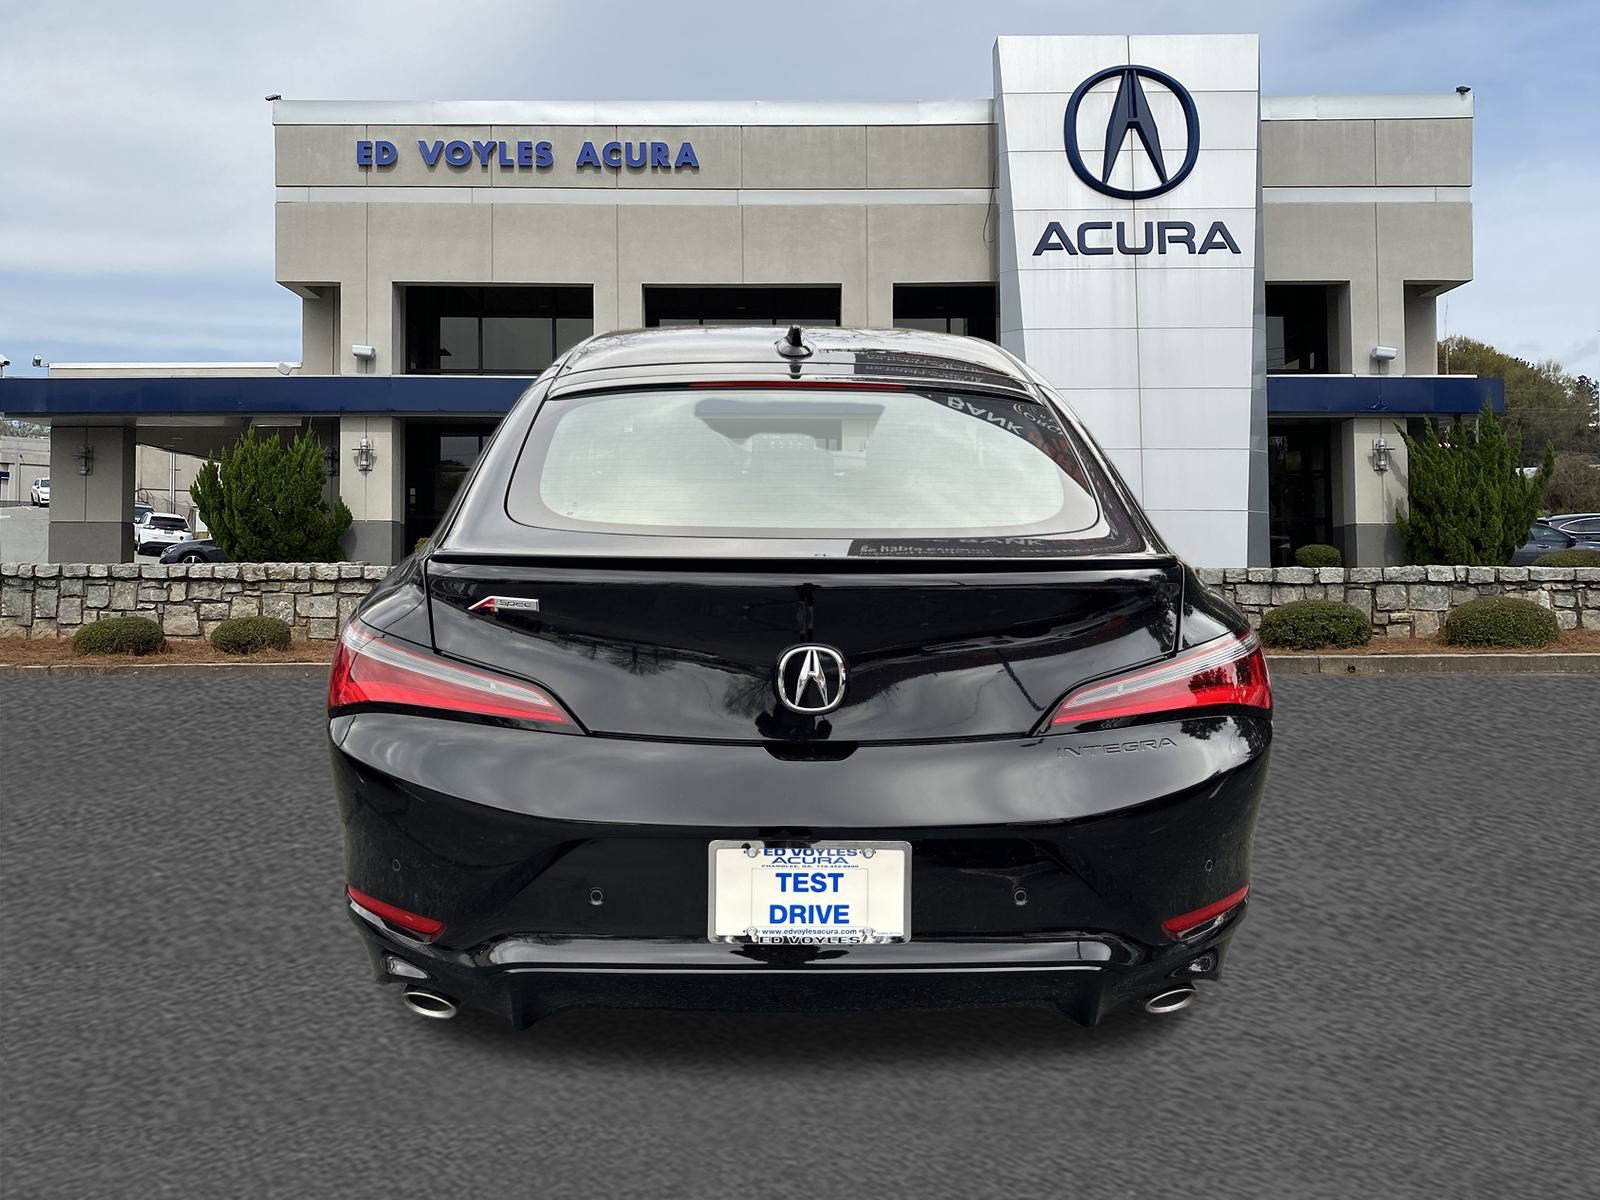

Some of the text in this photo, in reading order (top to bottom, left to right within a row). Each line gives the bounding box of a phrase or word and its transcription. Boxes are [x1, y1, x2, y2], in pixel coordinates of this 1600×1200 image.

[356, 140, 701, 169] ED VOYLES ACURA
[1032, 221, 1242, 256] ACURA
[1057, 737, 1177, 758] INTEGRA
[763, 848, 858, 856] ED VOYLES
[772, 856, 849, 864] ACURA
[775, 872, 844, 893] TEST
[769, 904, 850, 924] DRIVE
[759, 936, 861, 944] ED VOYLES
[762, 928, 857, 936] www.edvoylesacura.com
